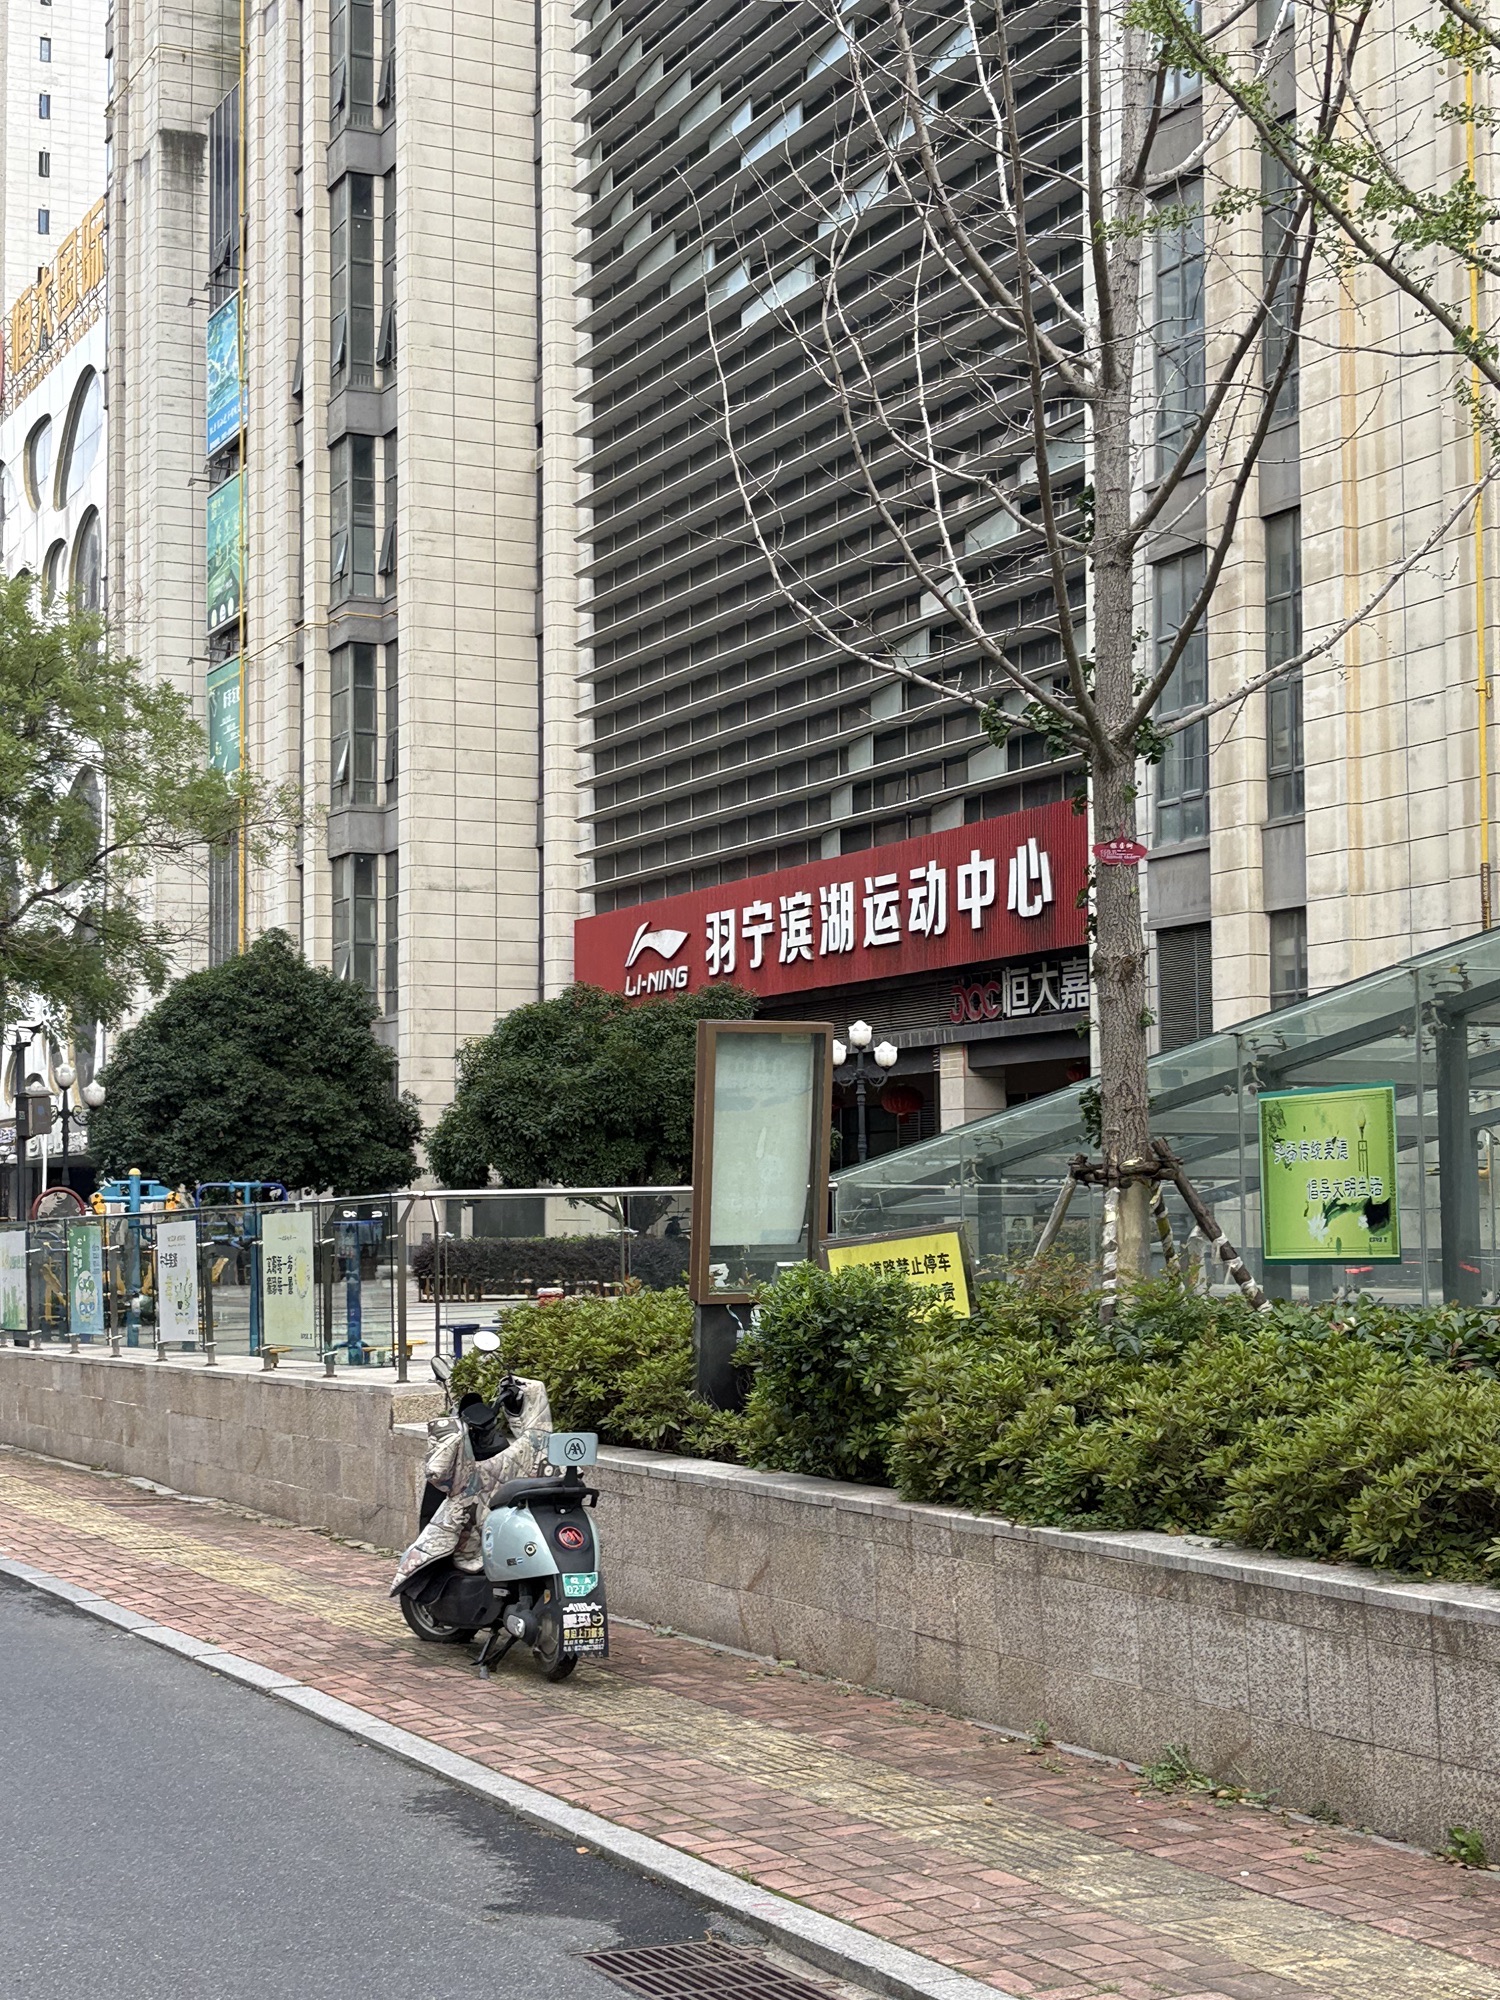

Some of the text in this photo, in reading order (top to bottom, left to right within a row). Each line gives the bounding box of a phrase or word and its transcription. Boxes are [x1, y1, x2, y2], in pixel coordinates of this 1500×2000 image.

[705, 838, 1054, 976] 羽宁滨湖运动中心
[624, 965, 690, 997] LI-NING
[1307, 1177, 1383, 1200] 倡导文明生活
